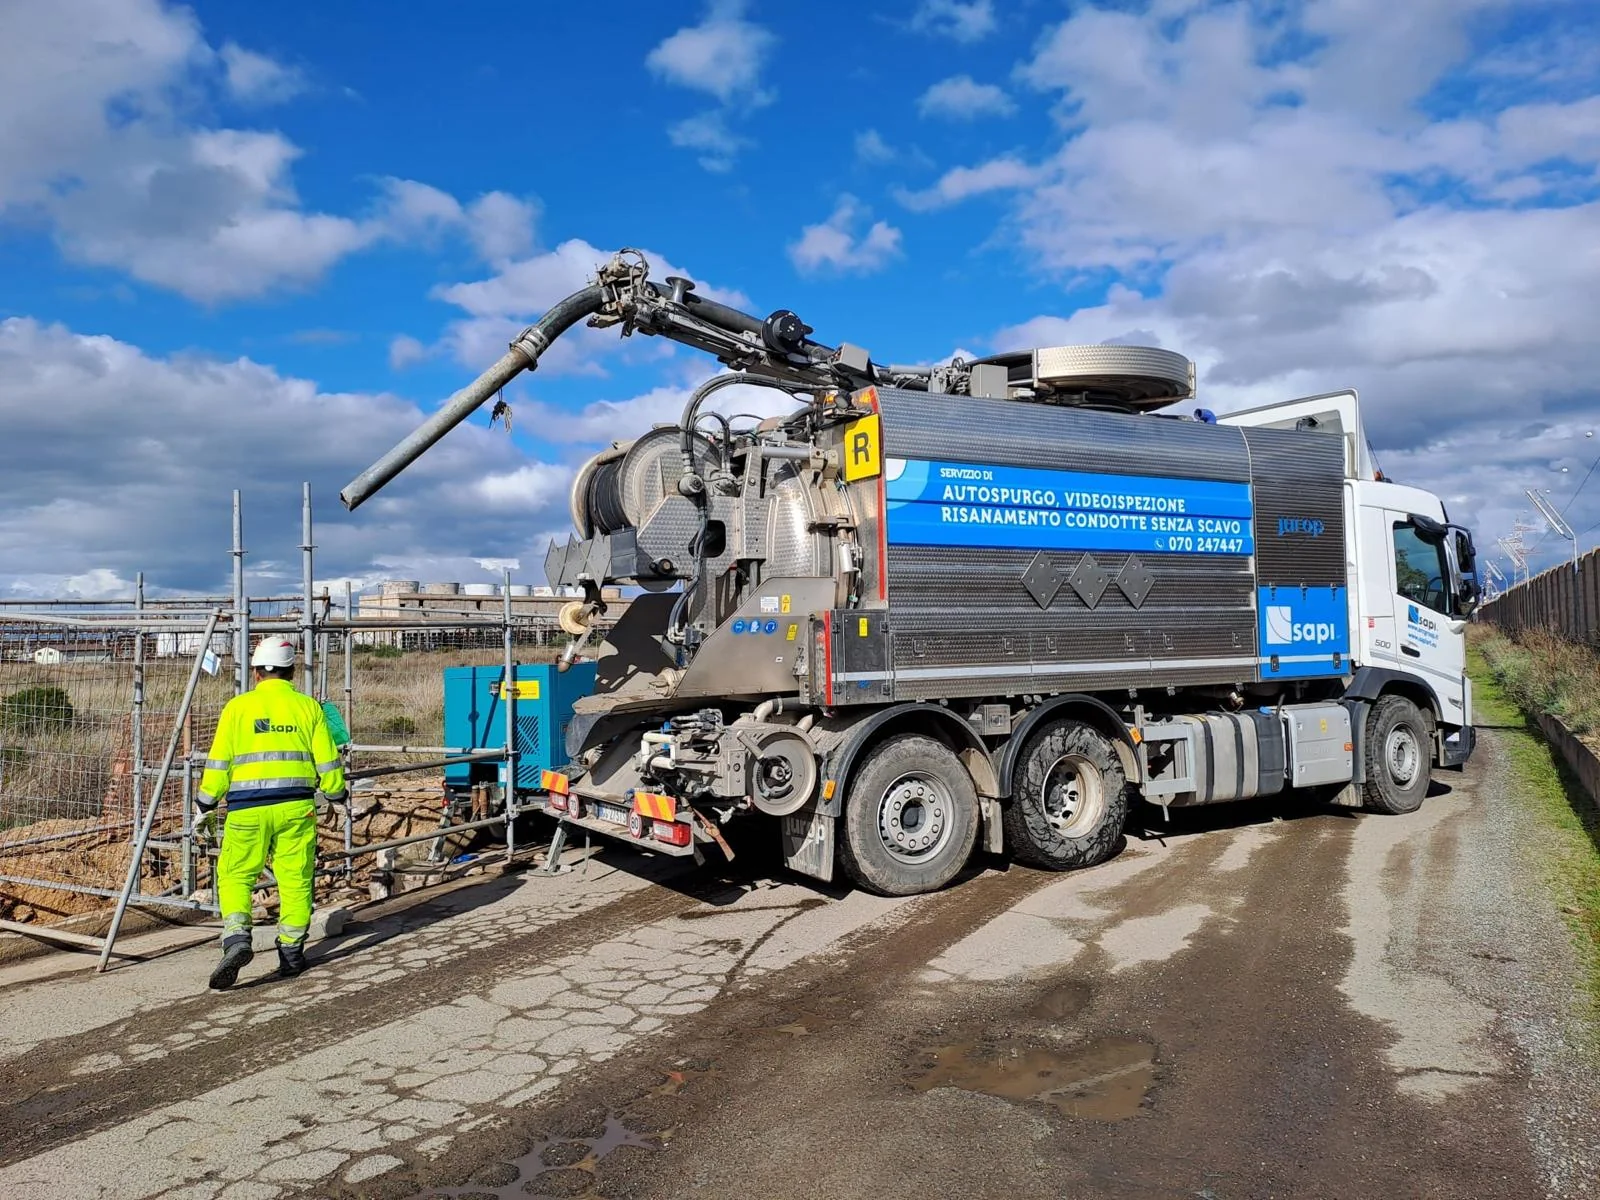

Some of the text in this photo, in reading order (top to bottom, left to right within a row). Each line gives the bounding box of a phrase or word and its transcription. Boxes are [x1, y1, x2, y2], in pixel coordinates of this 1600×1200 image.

[853, 431, 870, 466] R
[940, 467, 993, 480] SERVIZIO DI
[943, 484, 1186, 513] AUTOSPURGO, VIDEOISPEZIONE
[942, 507, 1241, 534] RISANAMENTO CONDOTTE SENZA SCAVO
[1168, 536, 1243, 552] 070 247447
[1375, 639, 1391, 649] 500
